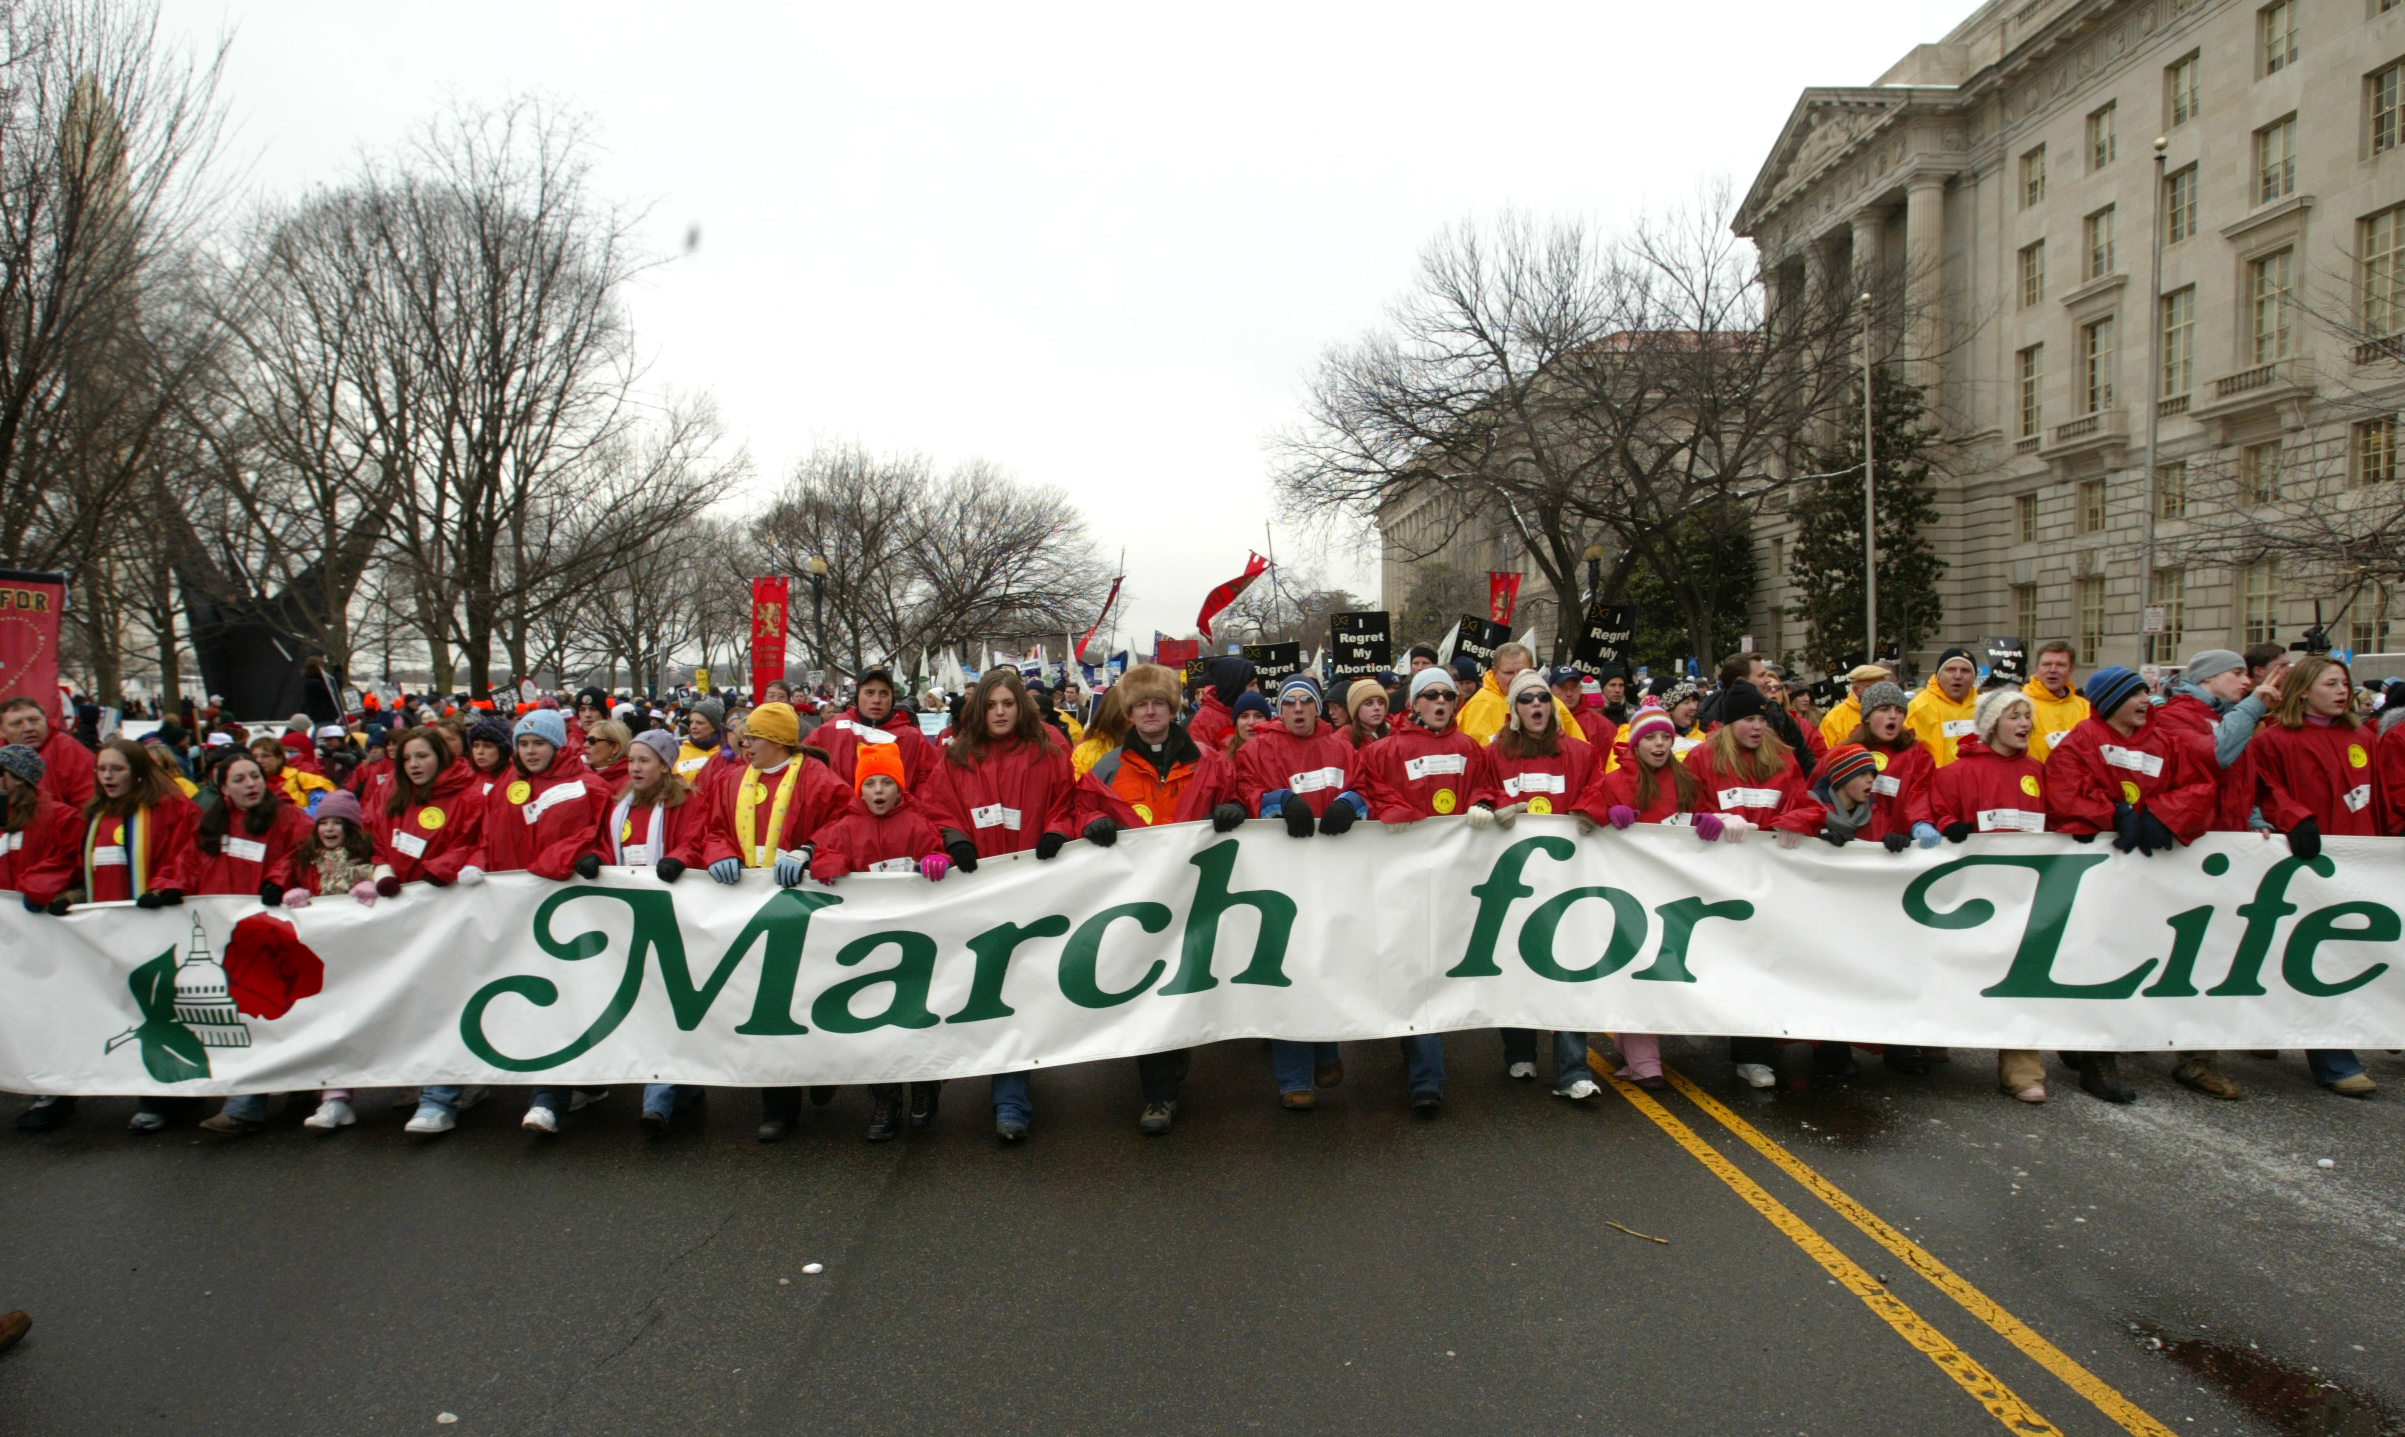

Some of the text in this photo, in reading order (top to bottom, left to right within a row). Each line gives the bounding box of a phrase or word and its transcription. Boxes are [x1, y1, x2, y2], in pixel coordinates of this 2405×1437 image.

[0, 587, 50, 613] FOR
[1358, 618, 1364, 629] I
[1615, 613, 1621, 625] I
[1339, 632, 1385, 645] Regret
[1484, 628, 1490, 640] I
[1590, 627, 1631, 643] Regret
[1352, 648, 1372, 660] My
[1461, 639, 1496, 659] Regre
[1599, 646, 1618, 661] My
[1988, 649, 2023, 658] Regret
[1270, 650, 1276, 661] I
[1334, 662, 1391, 674] Abortion
[460, 836, 2402, 1073] March for Life
